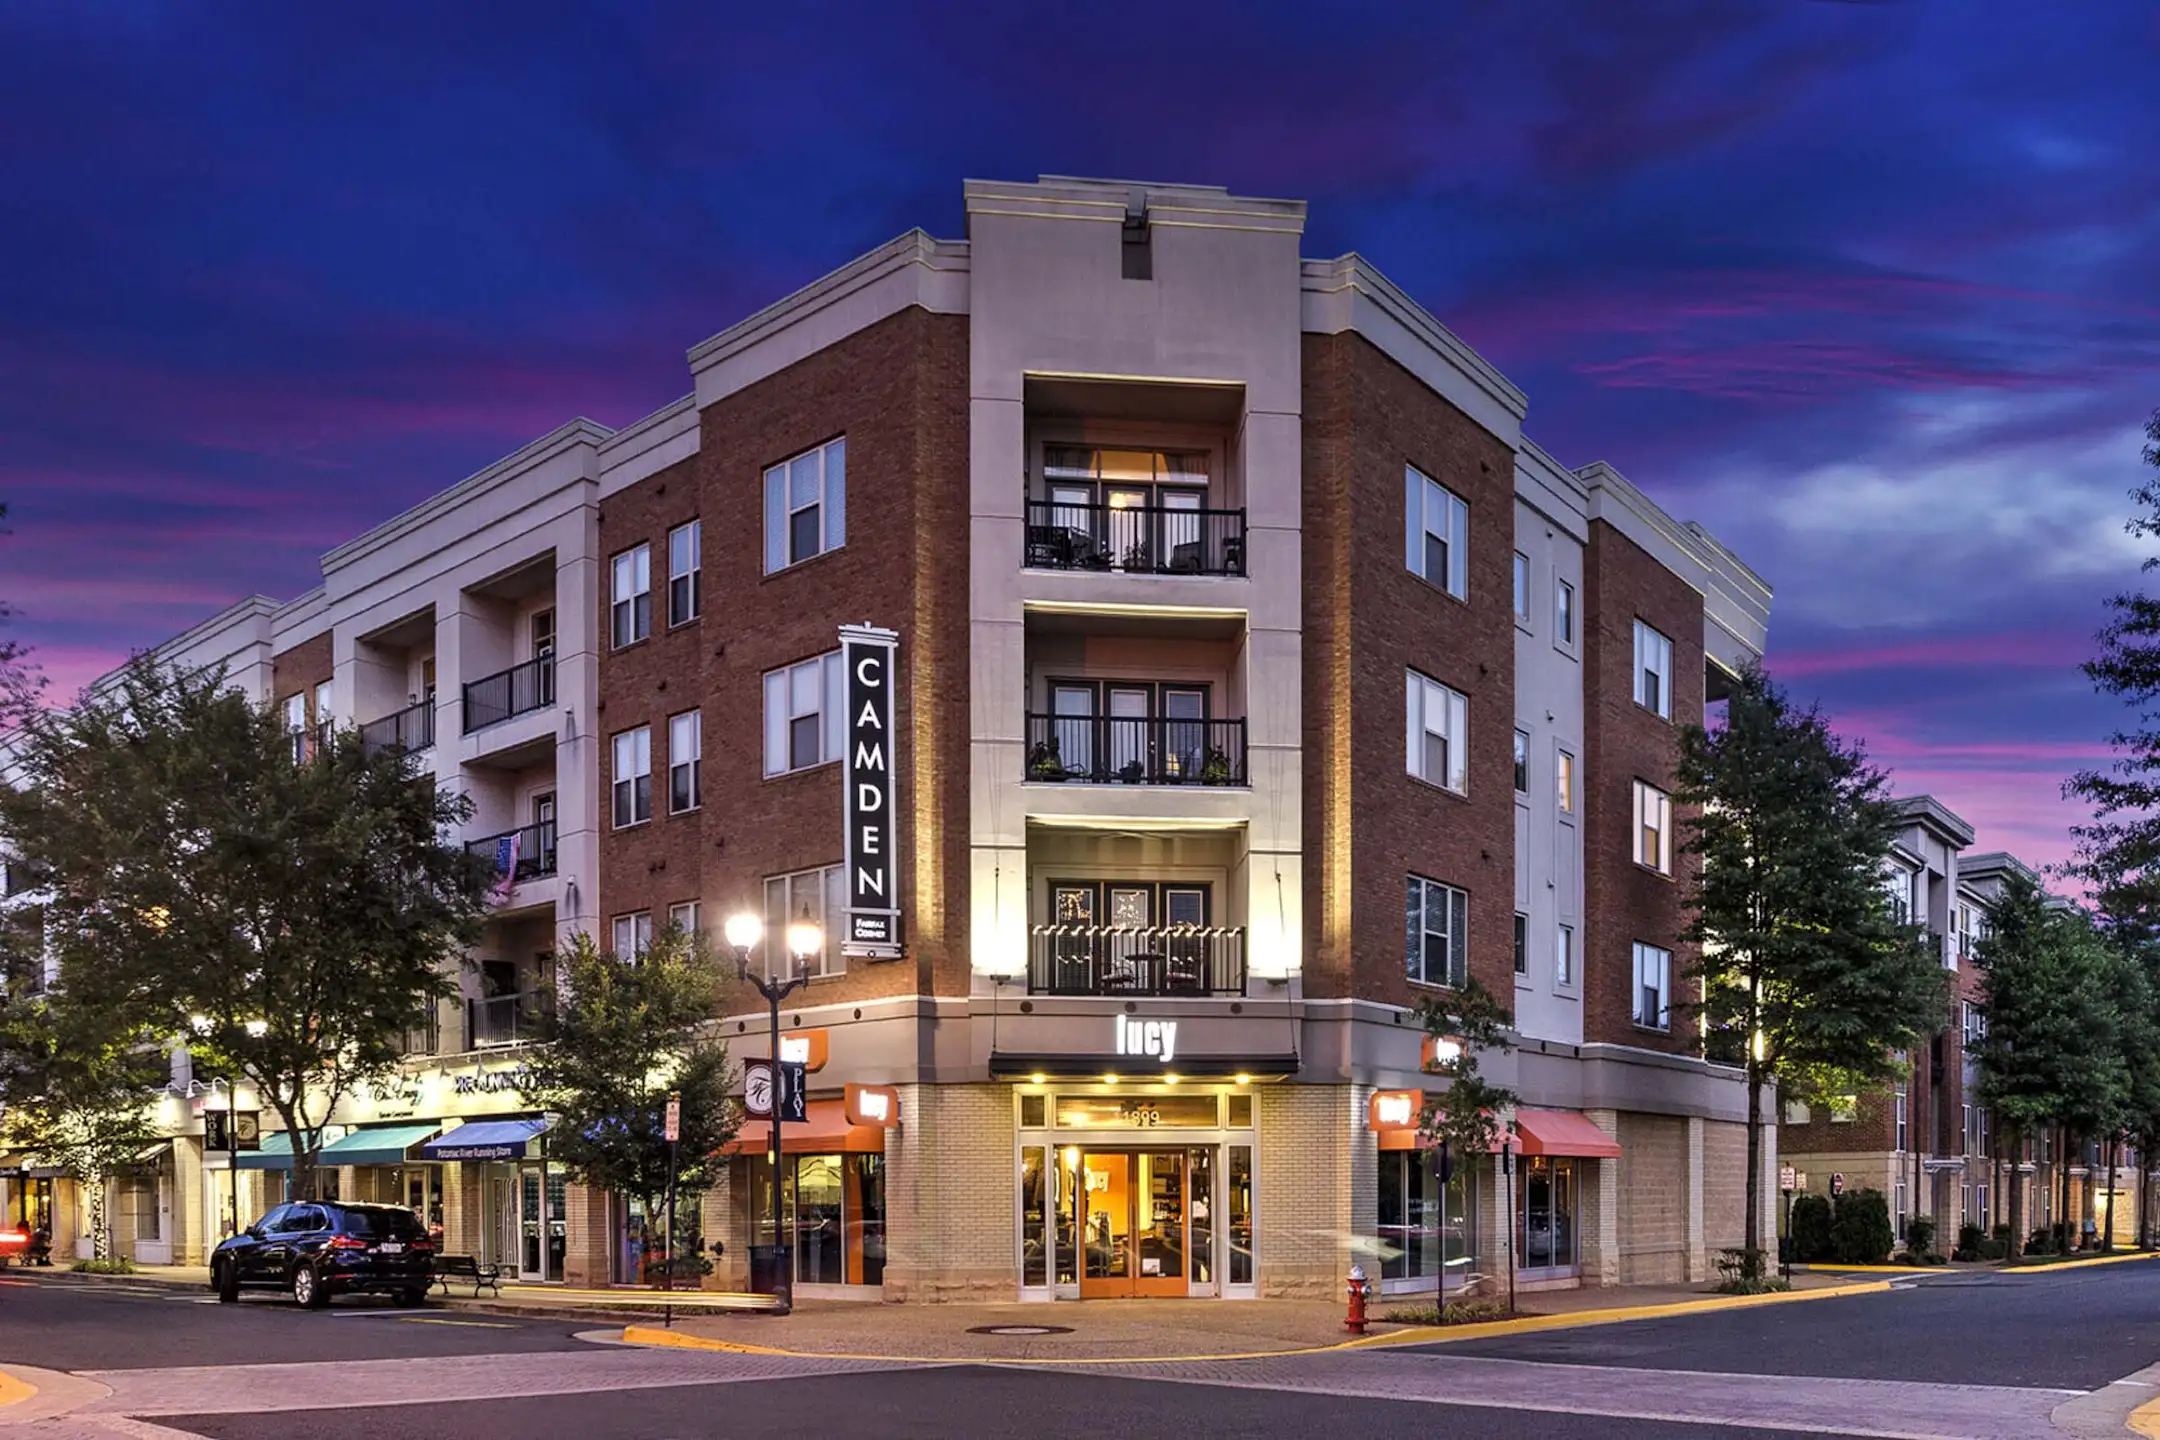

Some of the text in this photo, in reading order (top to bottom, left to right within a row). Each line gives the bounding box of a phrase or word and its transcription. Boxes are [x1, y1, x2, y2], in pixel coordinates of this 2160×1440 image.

[855, 658, 884, 896] CAMDEN
[1116, 1014, 1177, 1062] lucy
[793, 1067, 804, 1117] PLAY
[206, 1112, 218, 1147] WORK
